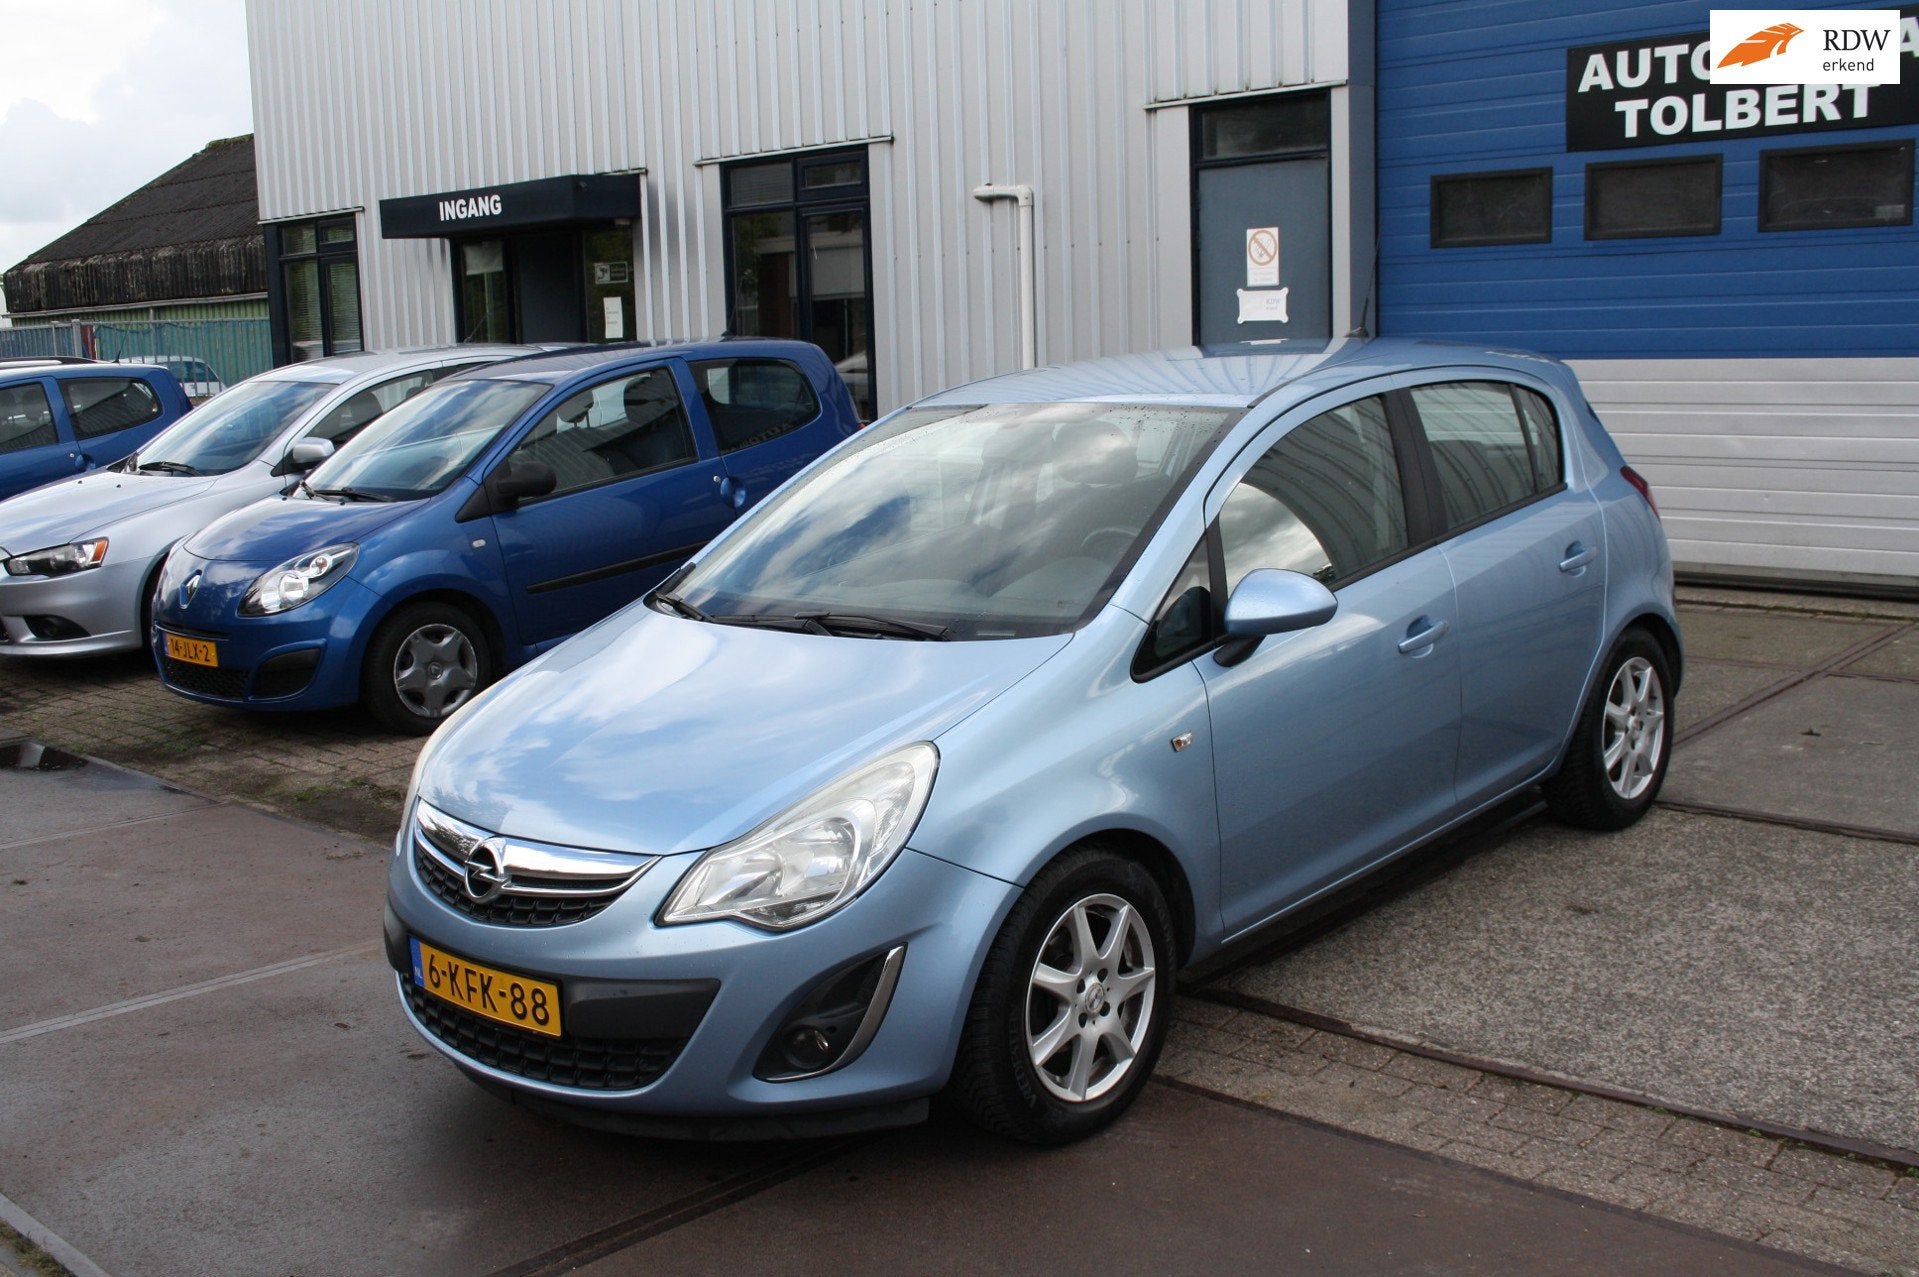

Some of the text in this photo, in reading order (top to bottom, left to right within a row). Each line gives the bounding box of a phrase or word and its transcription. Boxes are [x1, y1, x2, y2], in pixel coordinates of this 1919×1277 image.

[1615, 84, 1881, 138] TOLBERT
[439, 194, 502, 222] INGANG
[170, 639, 211, 662] 14-JLX-2
[429, 953, 550, 1026] 6-KFK-88
